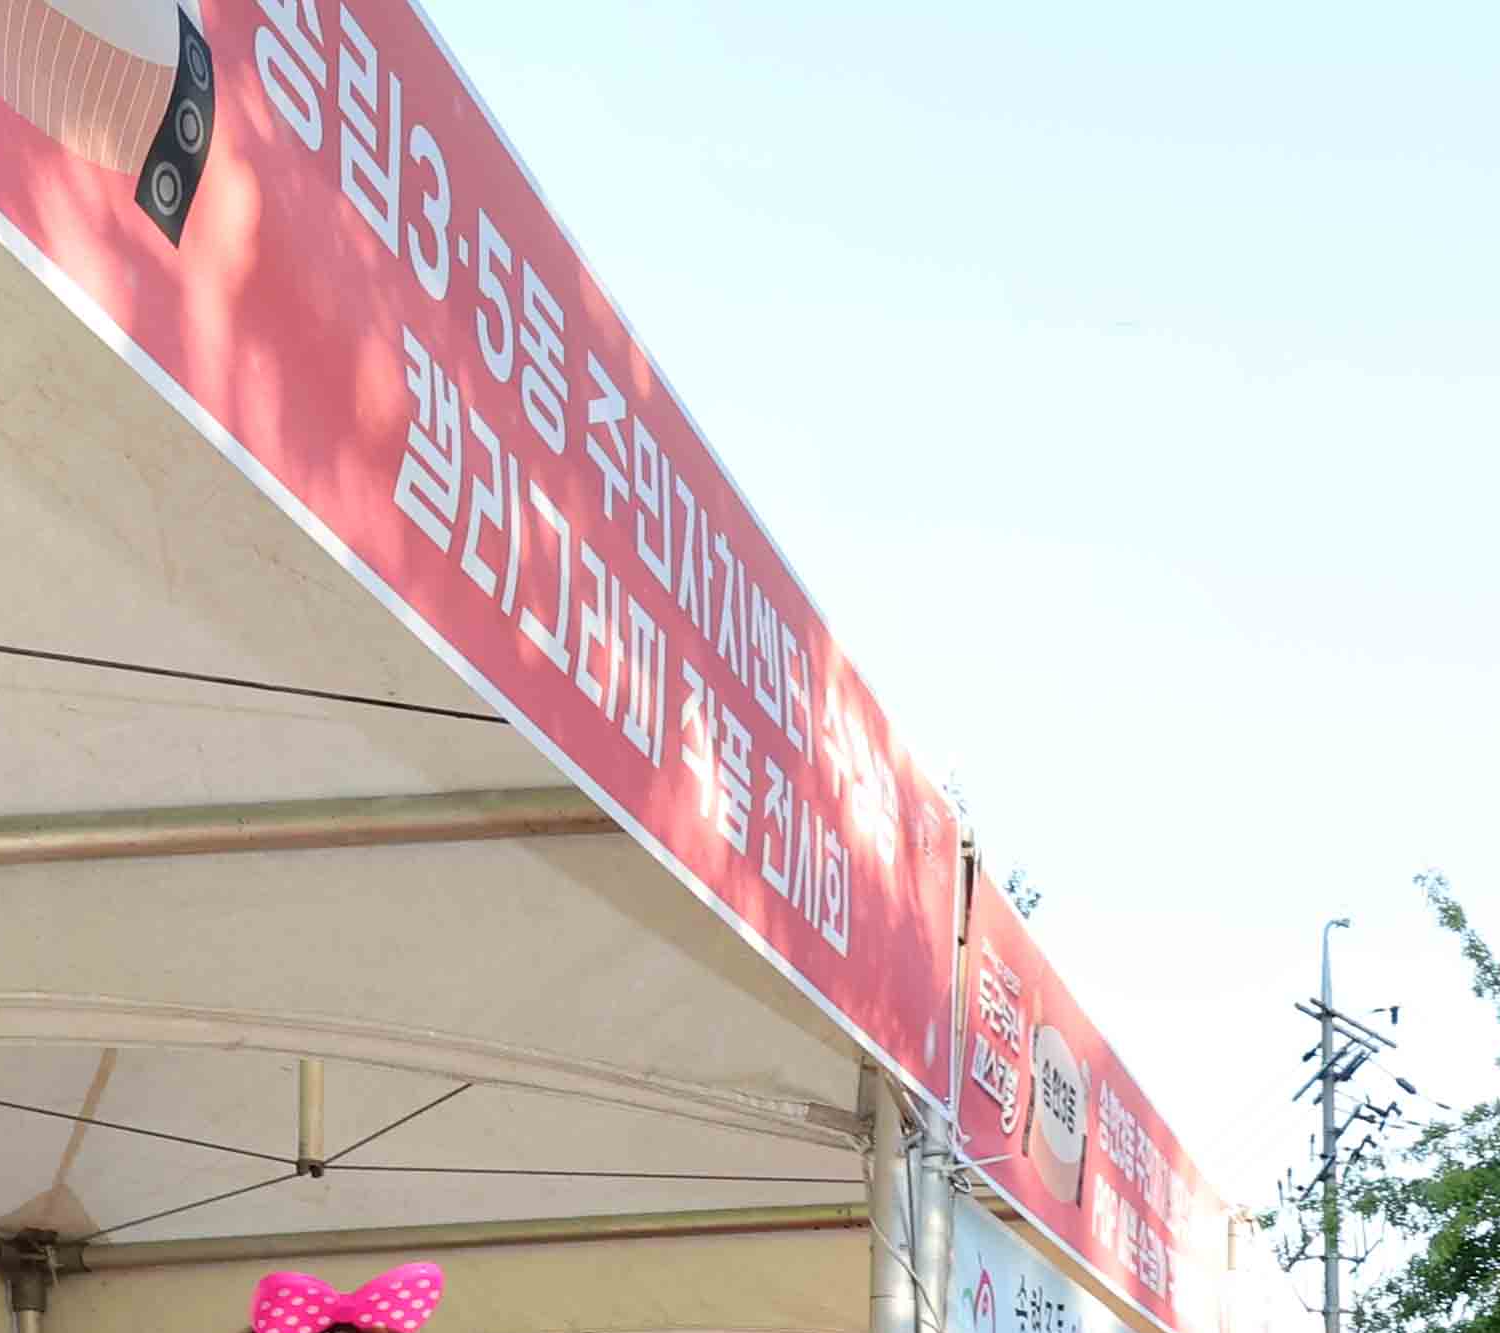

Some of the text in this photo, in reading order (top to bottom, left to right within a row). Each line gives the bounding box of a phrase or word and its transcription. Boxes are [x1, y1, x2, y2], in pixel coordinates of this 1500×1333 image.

[393, 324, 850, 958] 캘리그라피 작품 전시회
[586, 349, 813, 766] 주민자치센터
